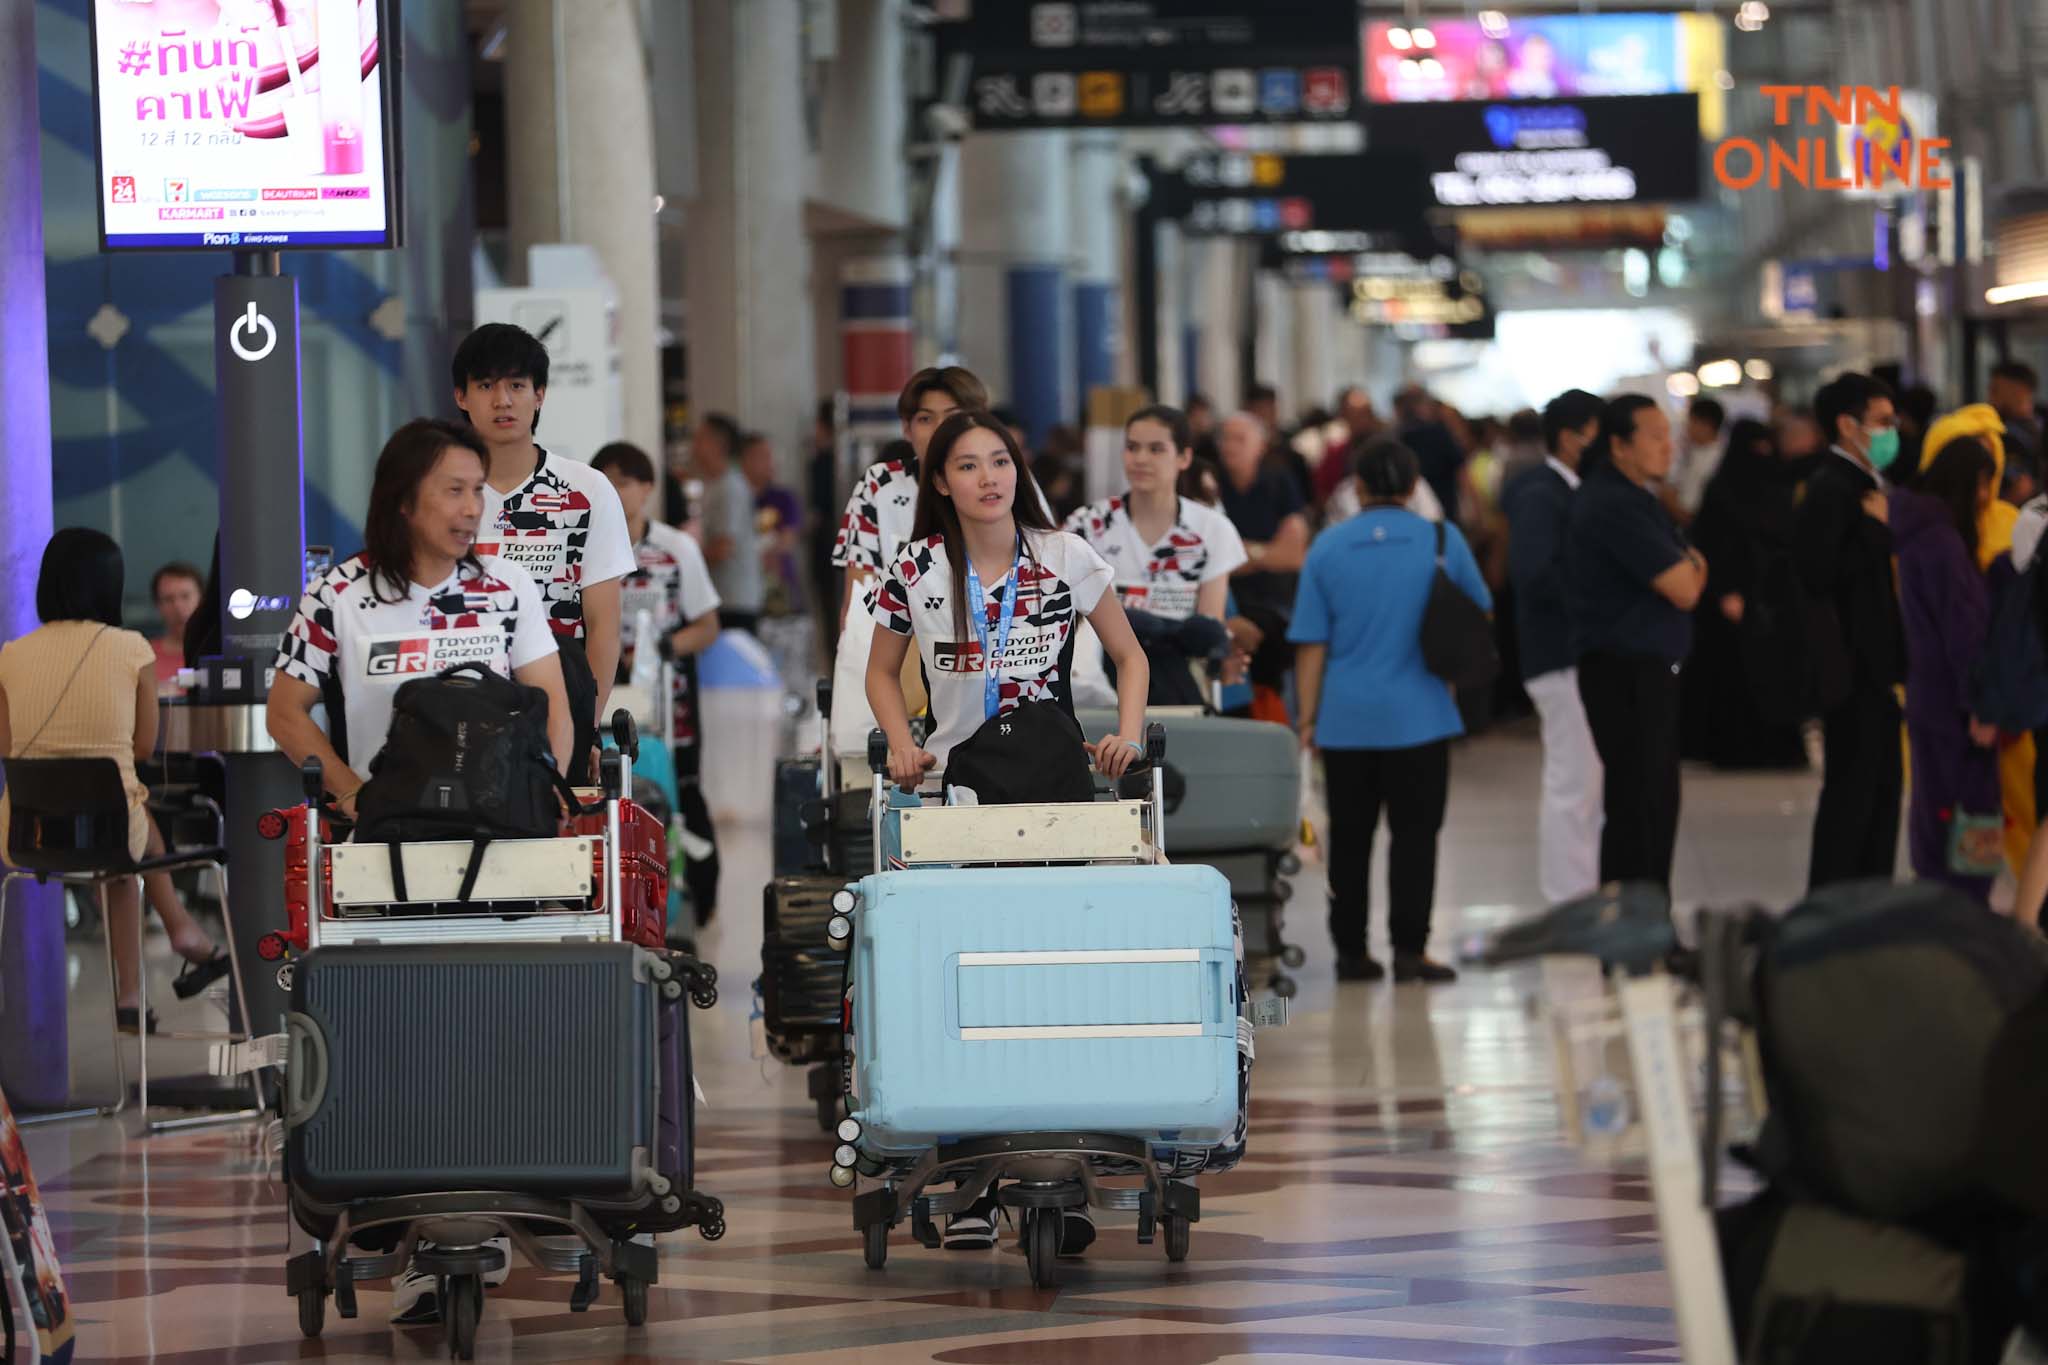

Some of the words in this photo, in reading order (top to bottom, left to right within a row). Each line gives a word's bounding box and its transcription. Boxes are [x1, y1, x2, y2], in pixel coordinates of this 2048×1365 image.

[141, 132, 159, 146] 12
[184, 132, 202, 145] 12
[114, 185, 134, 200] 24
[163, 209, 220, 219] KARMART
[504, 543, 562, 552] TOYOTA
[436, 634, 500, 648] TOYOTA
[433, 647, 495, 659] GAZOO
[368, 651, 426, 675] GR
[935, 652, 984, 671] GR
[990, 655, 1048, 670] Racing
